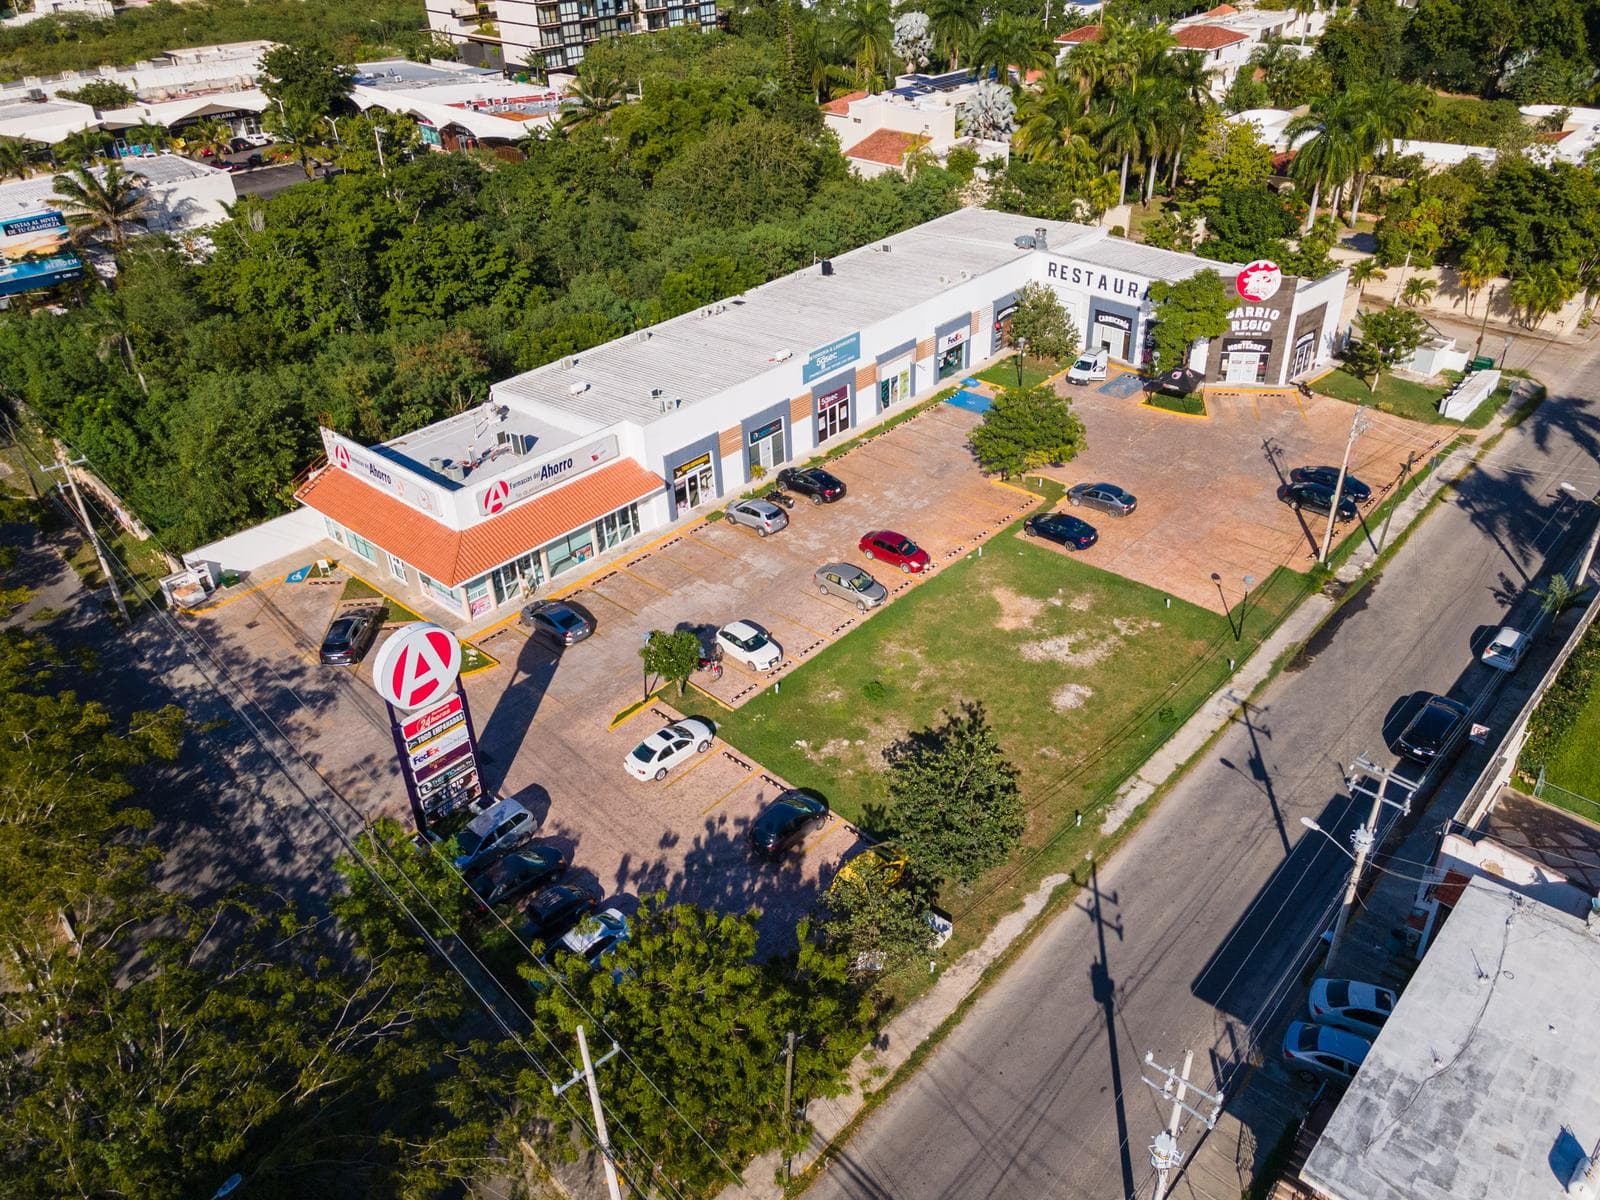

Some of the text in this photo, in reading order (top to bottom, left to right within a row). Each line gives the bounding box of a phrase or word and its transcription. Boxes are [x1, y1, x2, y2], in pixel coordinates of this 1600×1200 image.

[7, 228, 16, 236] DE
[26, 221, 61, 231] GRANDEZA
[9, 216, 58, 230] VISTAS AL NIVEL
[1231, 320, 1272, 332] REGIO
[1227, 342, 1266, 352] MONTERREY
[369, 462, 391, 485] Ahorro
[509, 474, 532, 490] Farmacias
[540, 457, 573, 481] Ahorro
[420, 714, 431, 732] 24
[430, 708, 451, 724] horas
[413, 746, 440, 766] FedEx
